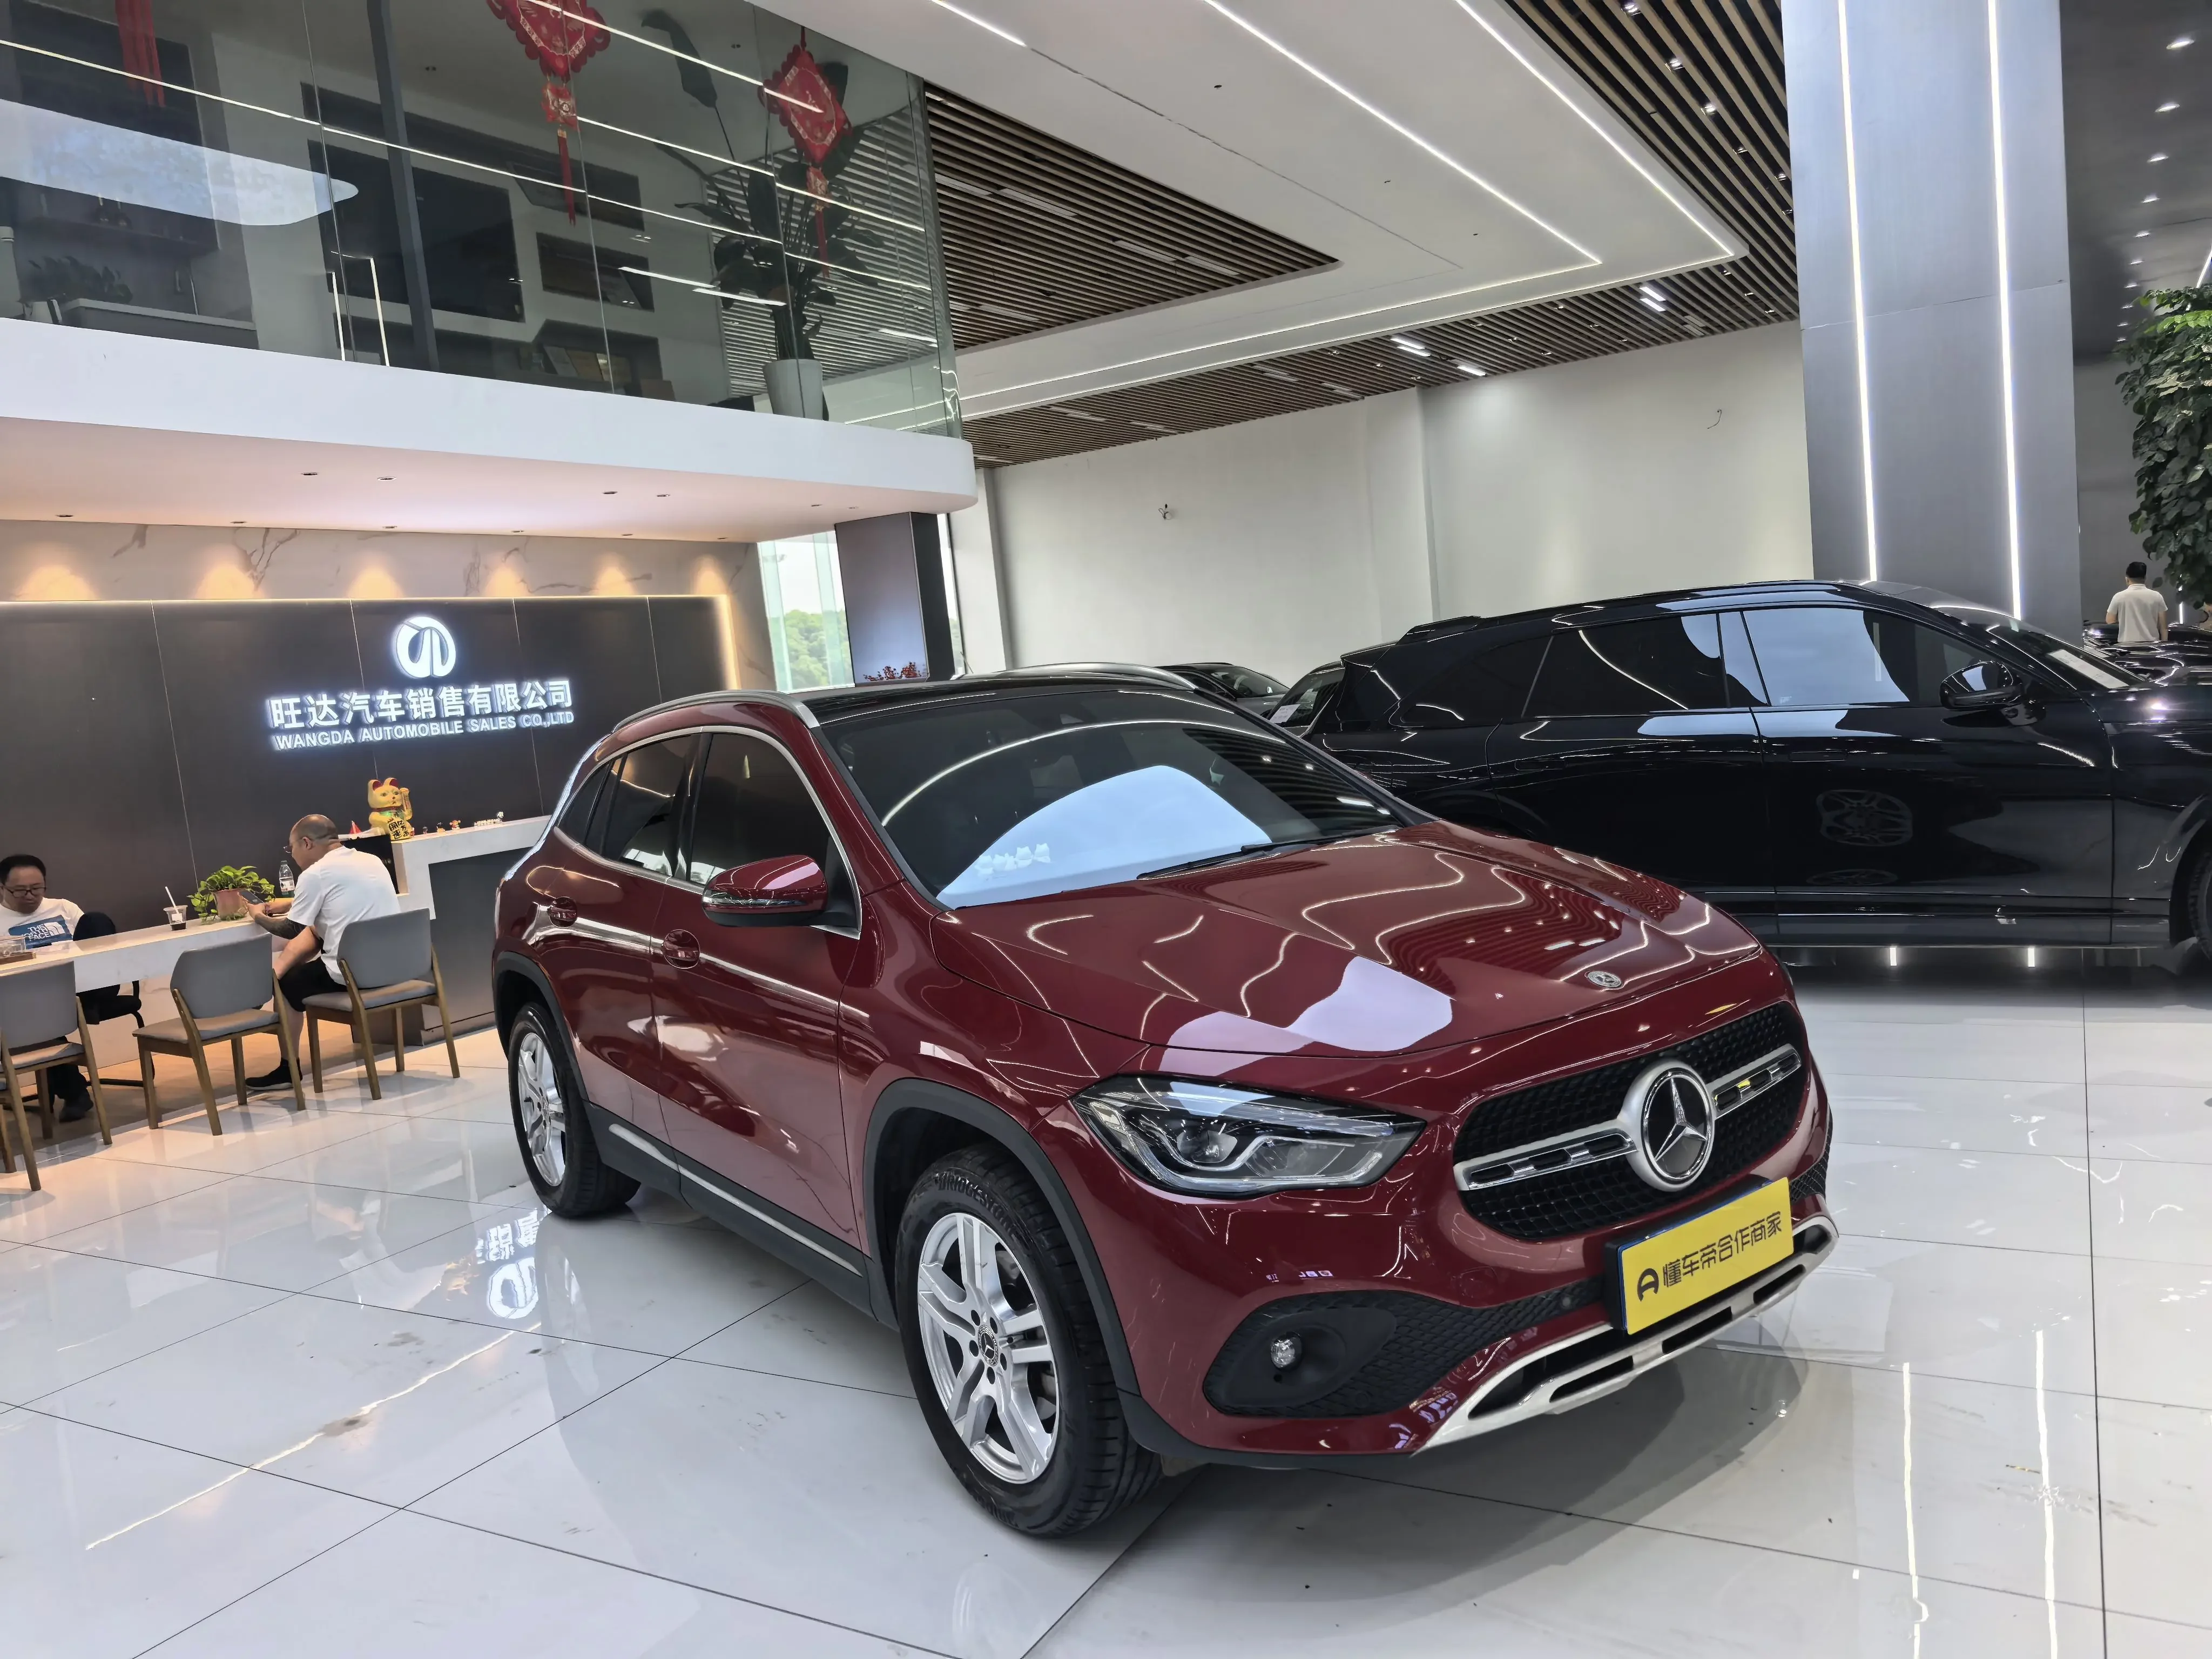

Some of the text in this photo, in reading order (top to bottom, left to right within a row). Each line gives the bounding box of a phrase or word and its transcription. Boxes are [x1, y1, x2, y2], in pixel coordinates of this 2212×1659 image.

[268, 680, 572, 729] 旺达汽车销售有限公司
[274, 730, 354, 750] WANGDA
[359, 722, 464, 743] AUTOMOBILE
[469, 716, 516, 733] SALES
[28, 924, 44, 933] THE
[29, 932, 51, 941] FACE
[1663, 1211, 1781, 1287] 懂车帝合作商家
